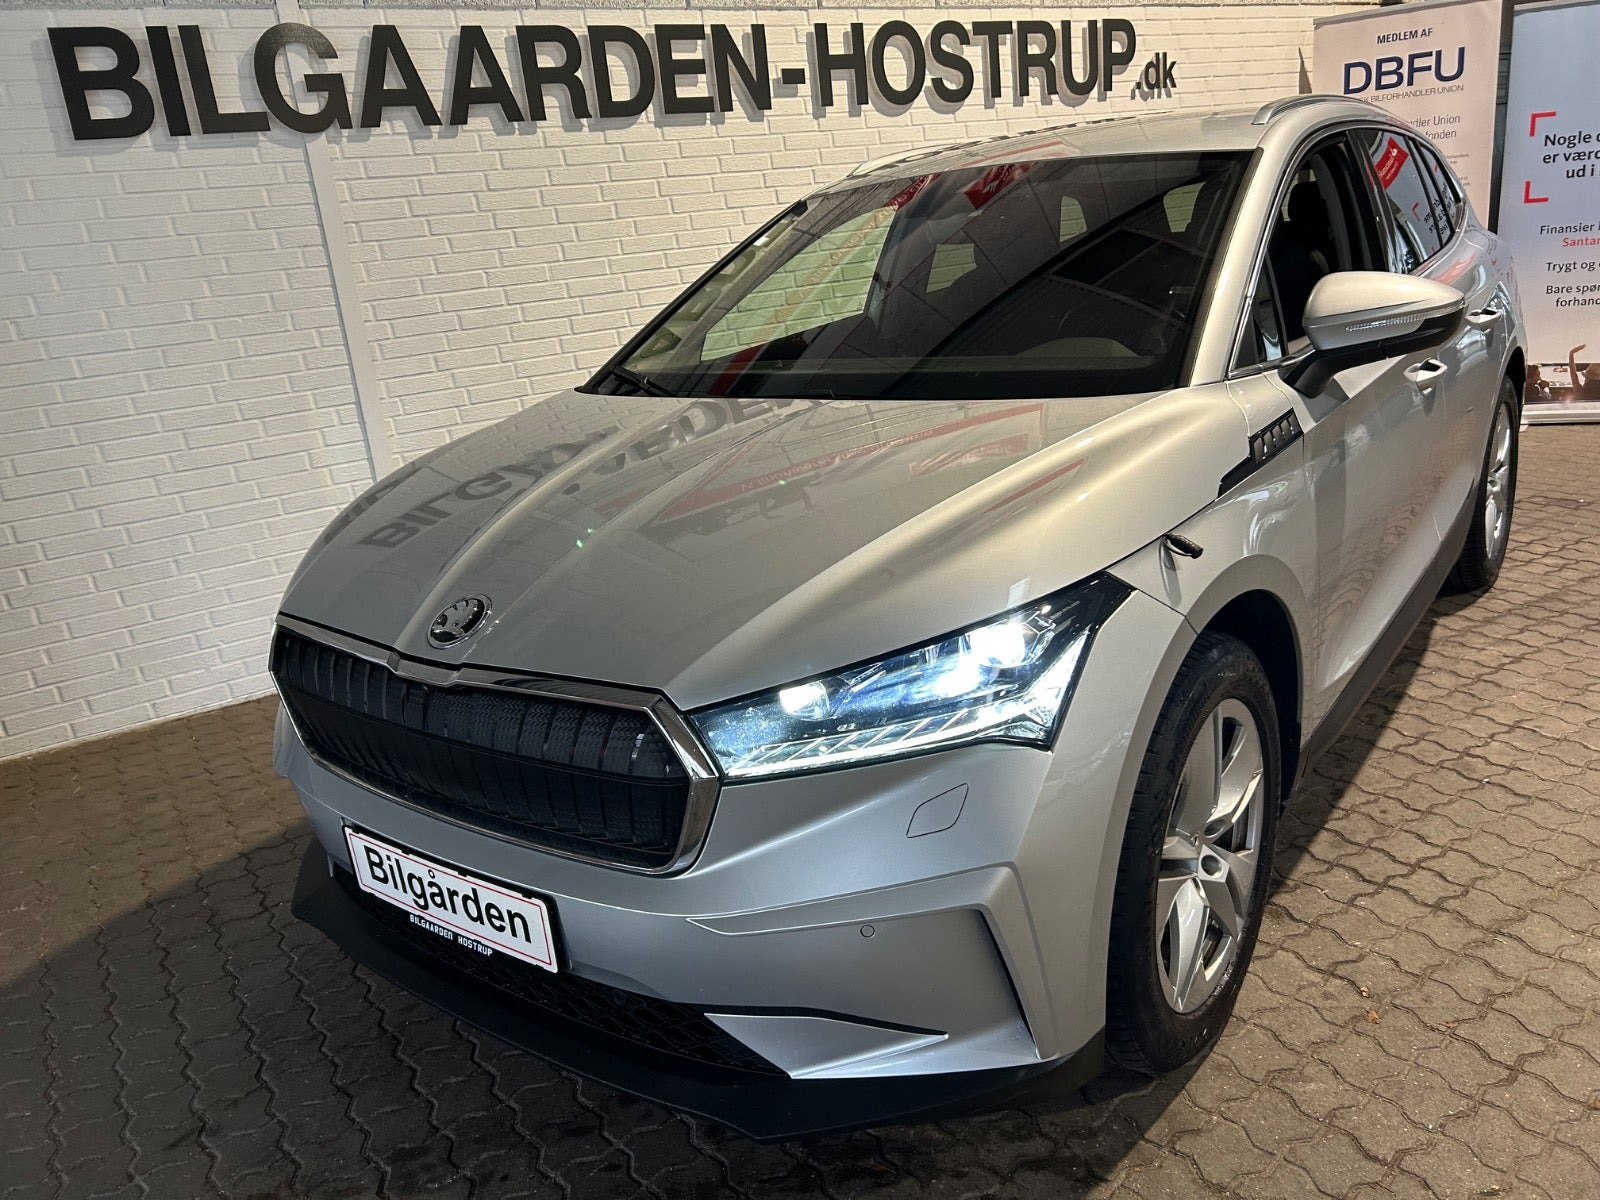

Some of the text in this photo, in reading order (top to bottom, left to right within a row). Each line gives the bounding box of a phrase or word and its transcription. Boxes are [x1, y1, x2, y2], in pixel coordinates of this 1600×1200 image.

[1376, 27, 1433, 45] MEDLEM AF
[1343, 47, 1466, 95] DBFU
[1371, 88, 1436, 102] BILFORHANDLER
[1437, 84, 1464, 94] UNION
[1433, 114, 1460, 126] Union
[1544, 131, 1592, 149] Nogle
[1542, 153, 1560, 164] er
[1566, 164, 1595, 179] ud i
[1540, 223, 1595, 235] Finansier
[1546, 261, 1577, 274] Trygt
[1580, 261, 1596, 272] og
[1546, 285, 1573, 294] Bare
[363, 844, 532, 944] Bilgården
[409, 914, 493, 957] BILGAARDEN HOSTRUP
